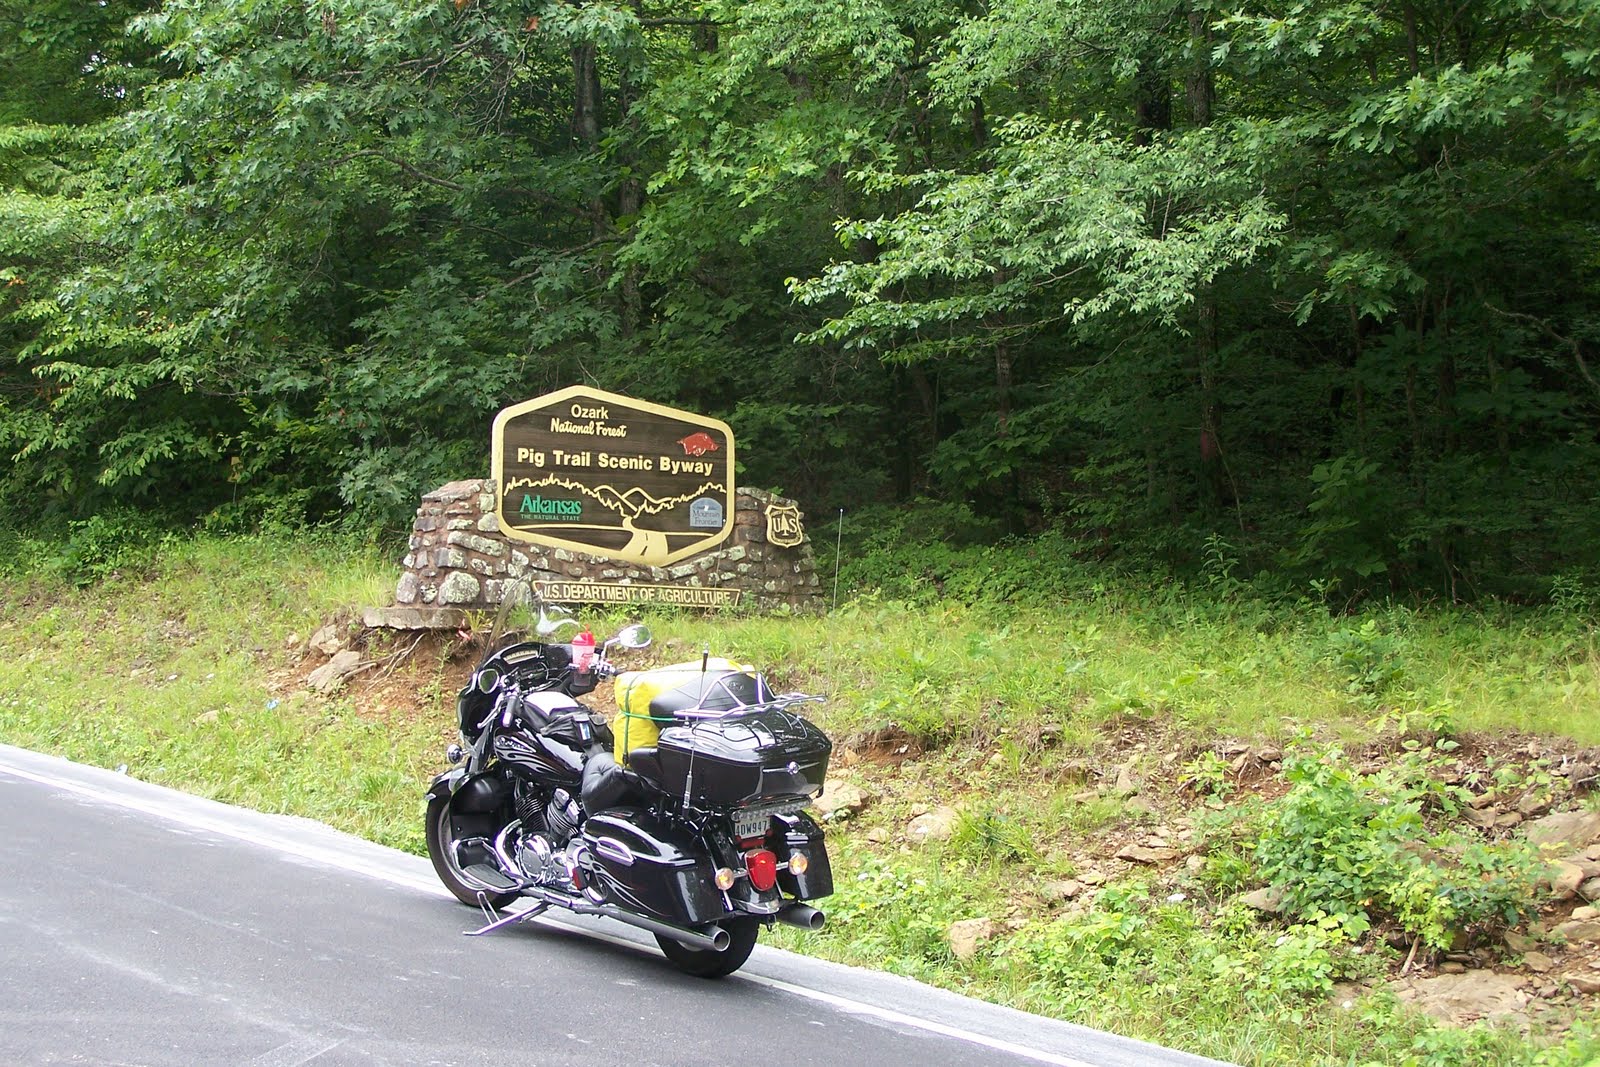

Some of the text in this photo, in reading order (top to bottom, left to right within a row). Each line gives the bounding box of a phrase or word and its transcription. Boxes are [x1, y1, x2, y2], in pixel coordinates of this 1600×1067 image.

[571, 404, 608, 420] Ozark
[550, 418, 626, 438] National Forest
[517, 448, 713, 476] Pig Trail Scenic Byway
[520, 495, 582, 515] Arkansas
[544, 585, 730, 605] U.S. DEPARTMENT OF AGRICULTURE
